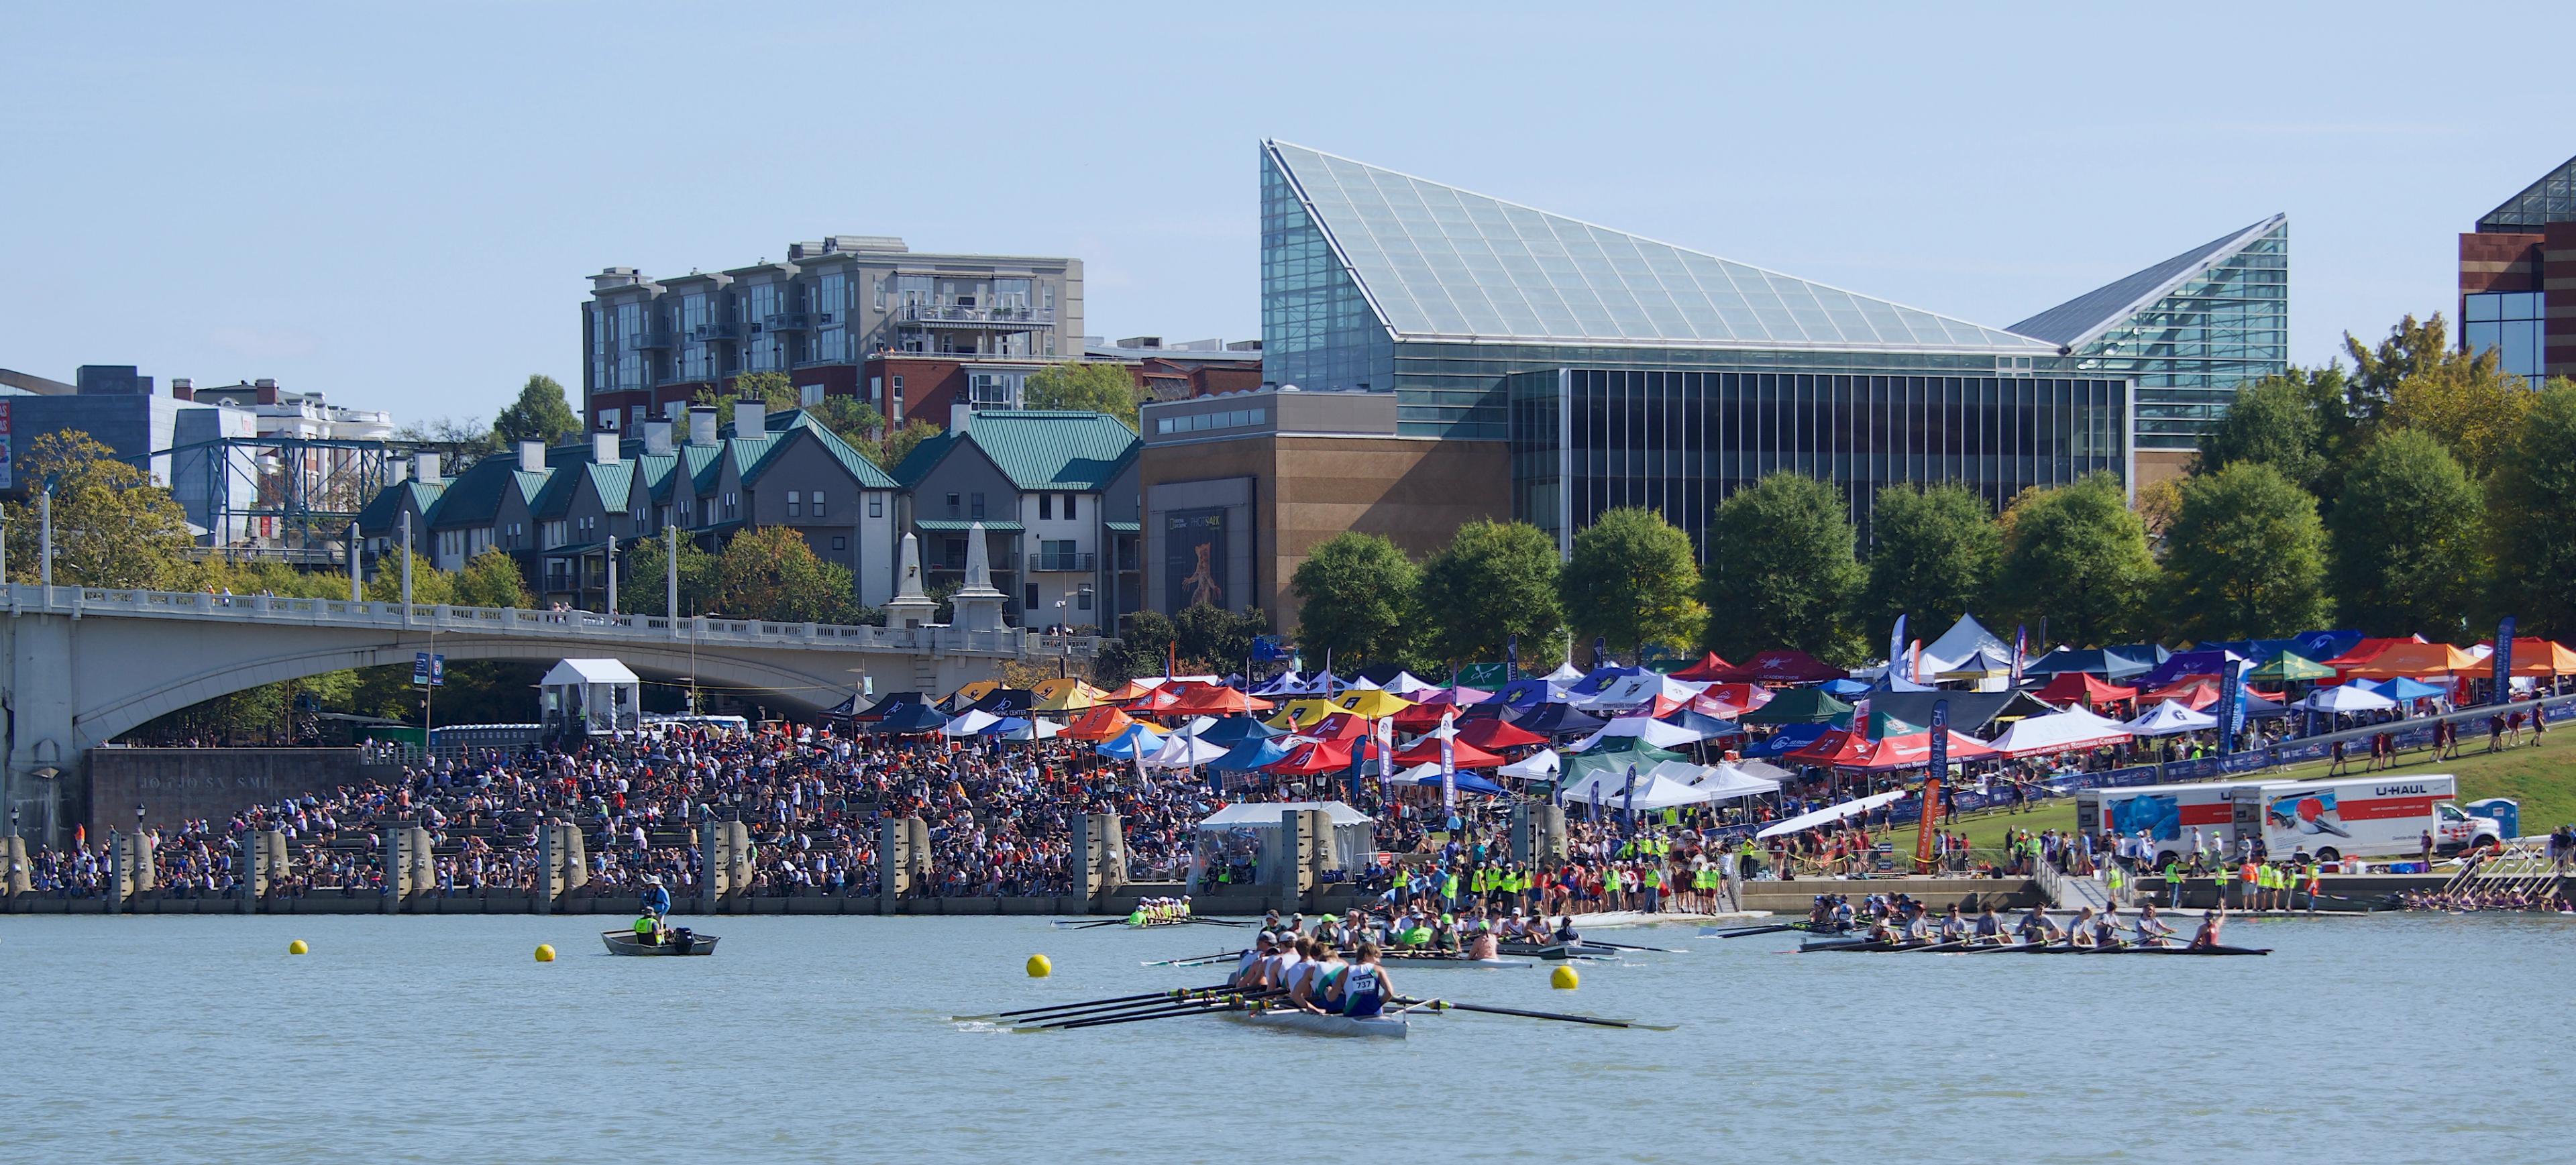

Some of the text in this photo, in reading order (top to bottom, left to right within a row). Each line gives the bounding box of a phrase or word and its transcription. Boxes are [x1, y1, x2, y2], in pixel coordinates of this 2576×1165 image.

[2171, 710, 2188, 720] G
[1893, 761, 1911, 769] Vero
[1446, 776, 1454, 807] Boone
[2375, 785, 2427, 796] U-HAUL
[1922, 798, 1932, 842] RECOVERY
[1356, 980, 1371, 989] 737
